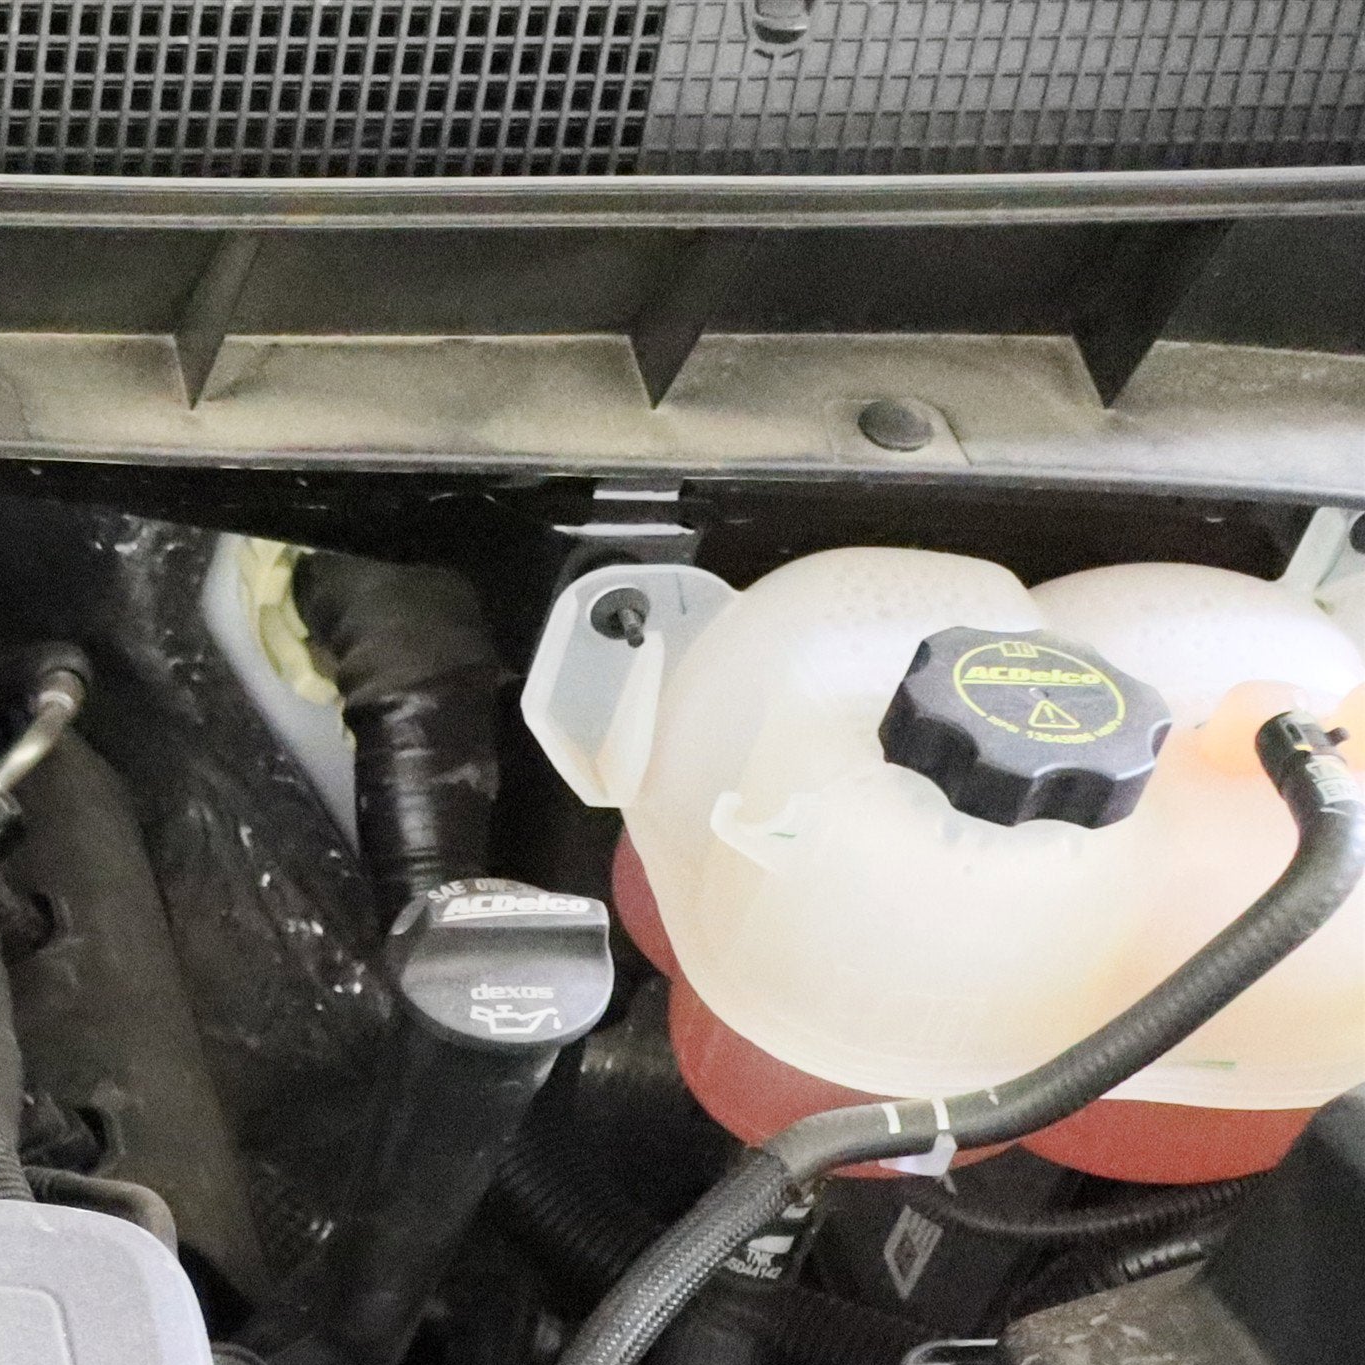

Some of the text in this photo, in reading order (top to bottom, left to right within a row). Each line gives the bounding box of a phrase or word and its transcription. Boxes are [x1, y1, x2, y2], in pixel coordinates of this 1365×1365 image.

[962, 665, 1102, 686] ACDelco
[427, 880, 467, 903] SAE
[442, 894, 591, 919] ACDelco
[470, 983, 555, 1001] dexos
